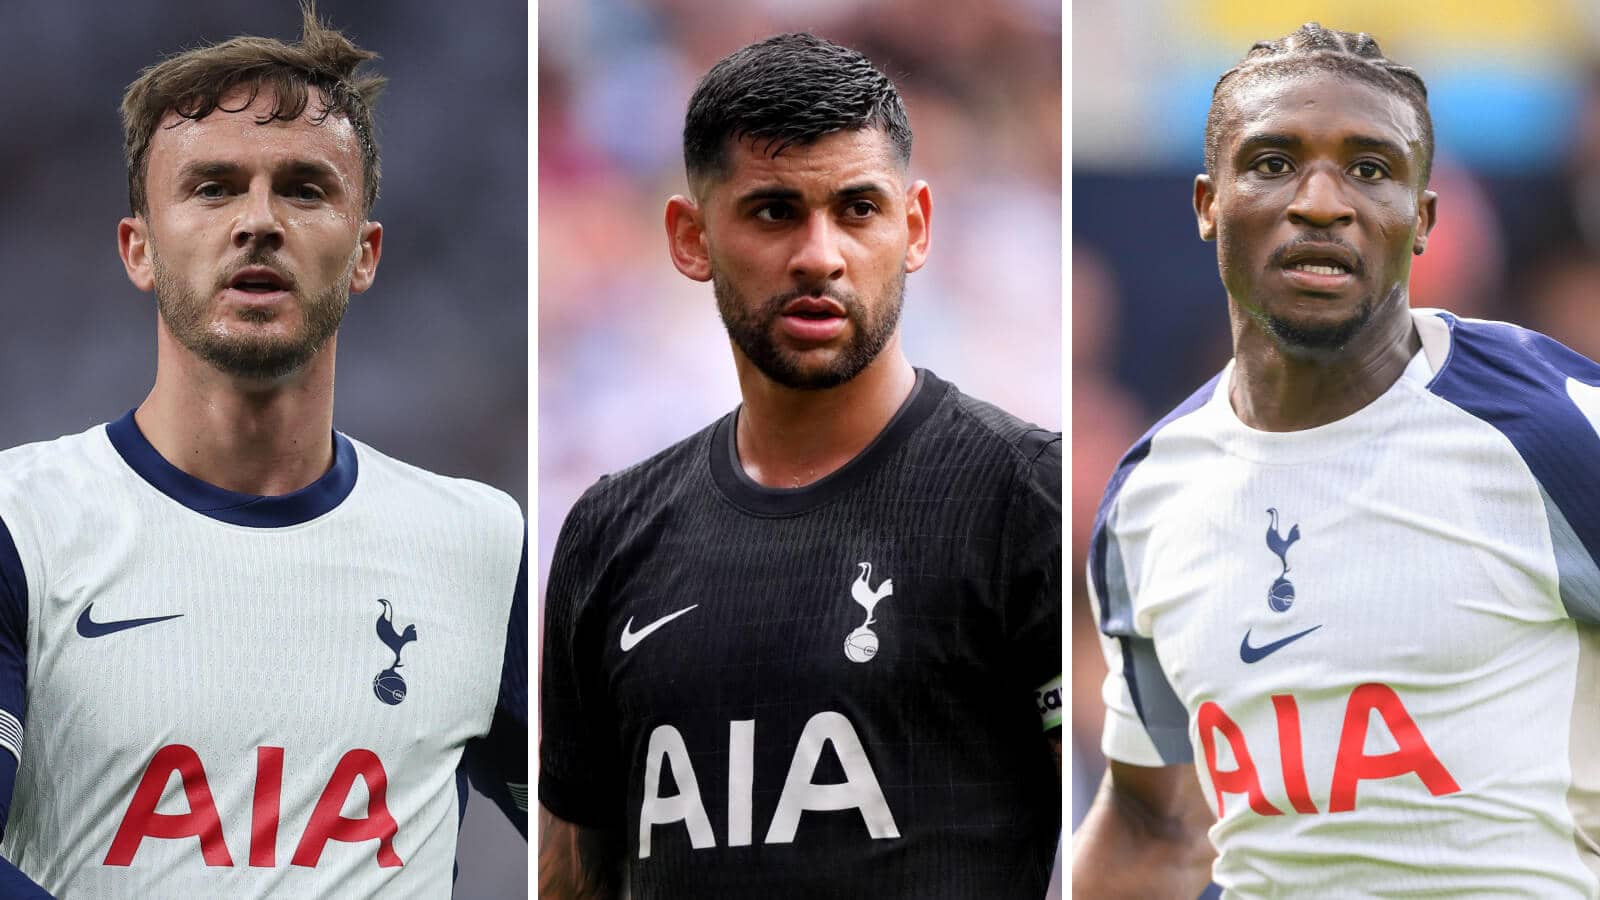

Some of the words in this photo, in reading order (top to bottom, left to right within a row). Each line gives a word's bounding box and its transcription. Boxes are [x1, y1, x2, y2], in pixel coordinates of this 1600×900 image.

[103, 743, 404, 868] AIA
[638, 711, 901, 858] AIA
[1197, 683, 1461, 818] AIA
